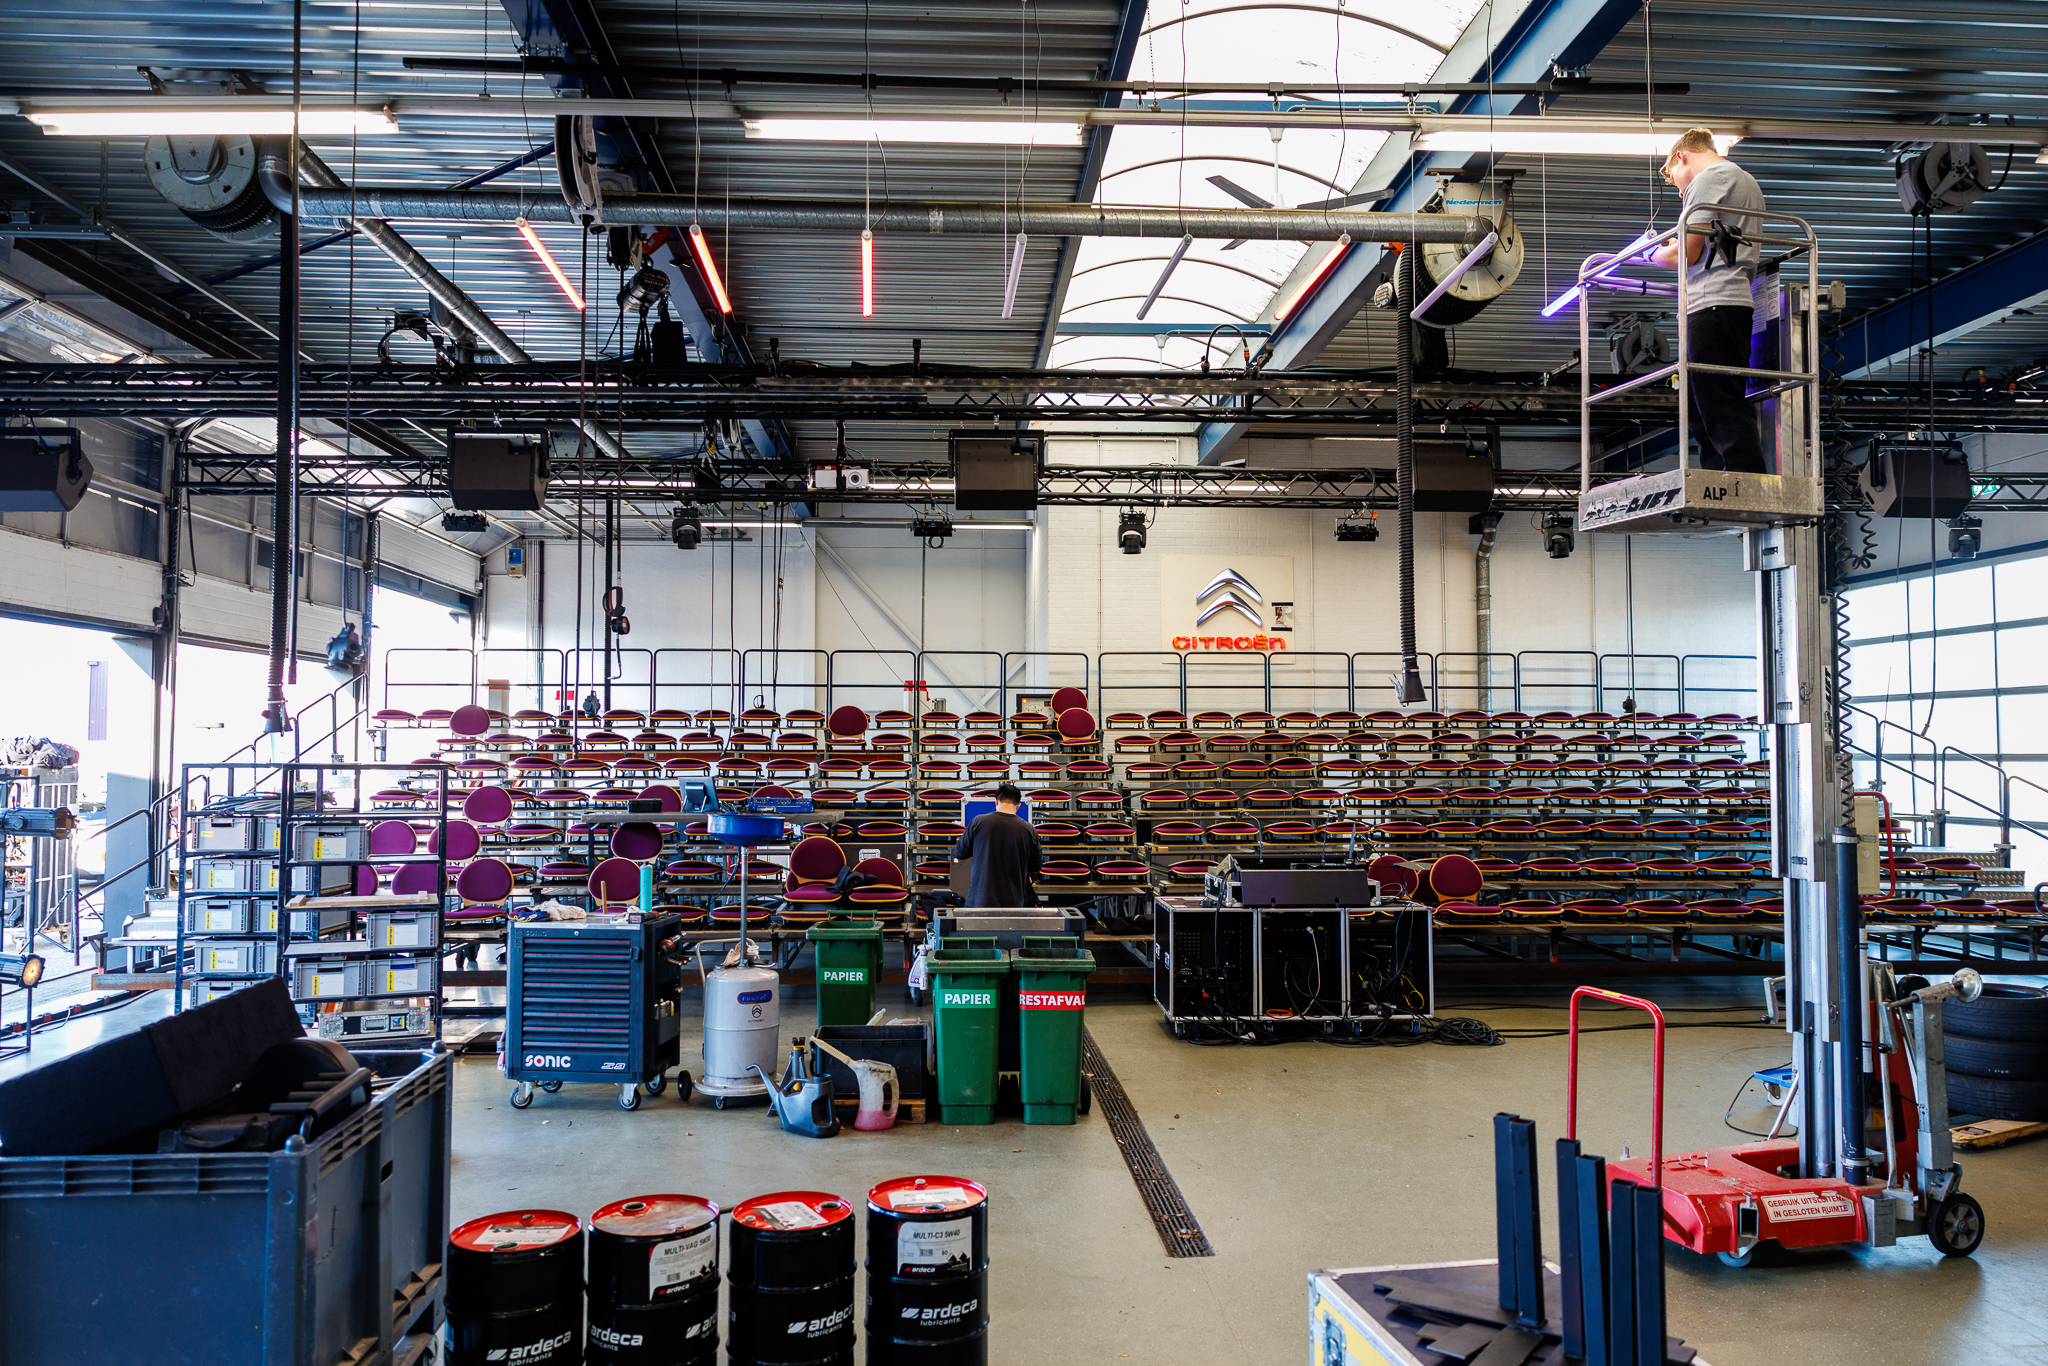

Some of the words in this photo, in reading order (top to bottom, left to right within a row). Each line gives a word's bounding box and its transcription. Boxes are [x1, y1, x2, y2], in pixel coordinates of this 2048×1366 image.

[824, 971, 863, 982] PAPIER
[944, 993, 991, 1005] PAPIER
[525, 1055, 571, 1068] SONIC
[1768, 1198, 1801, 1208] GEBRUIK
[1782, 1208, 1820, 1217] GESLOTEN
[1822, 1205, 1848, 1214] RUIMTE
[913, 1232, 943, 1240] MULTI-C3
[944, 1229, 960, 1239] 5W40
[664, 1240, 698, 1256] MULTI-VAG
[666, 1283, 690, 1294] ardeca
[922, 1299, 977, 1319] ardeca
[920, 1318, 960, 1326] lubricants
[590, 1324, 644, 1346] ardeca
[807, 1323, 842, 1338] lubricants
[509, 1330, 572, 1360] ardeca
